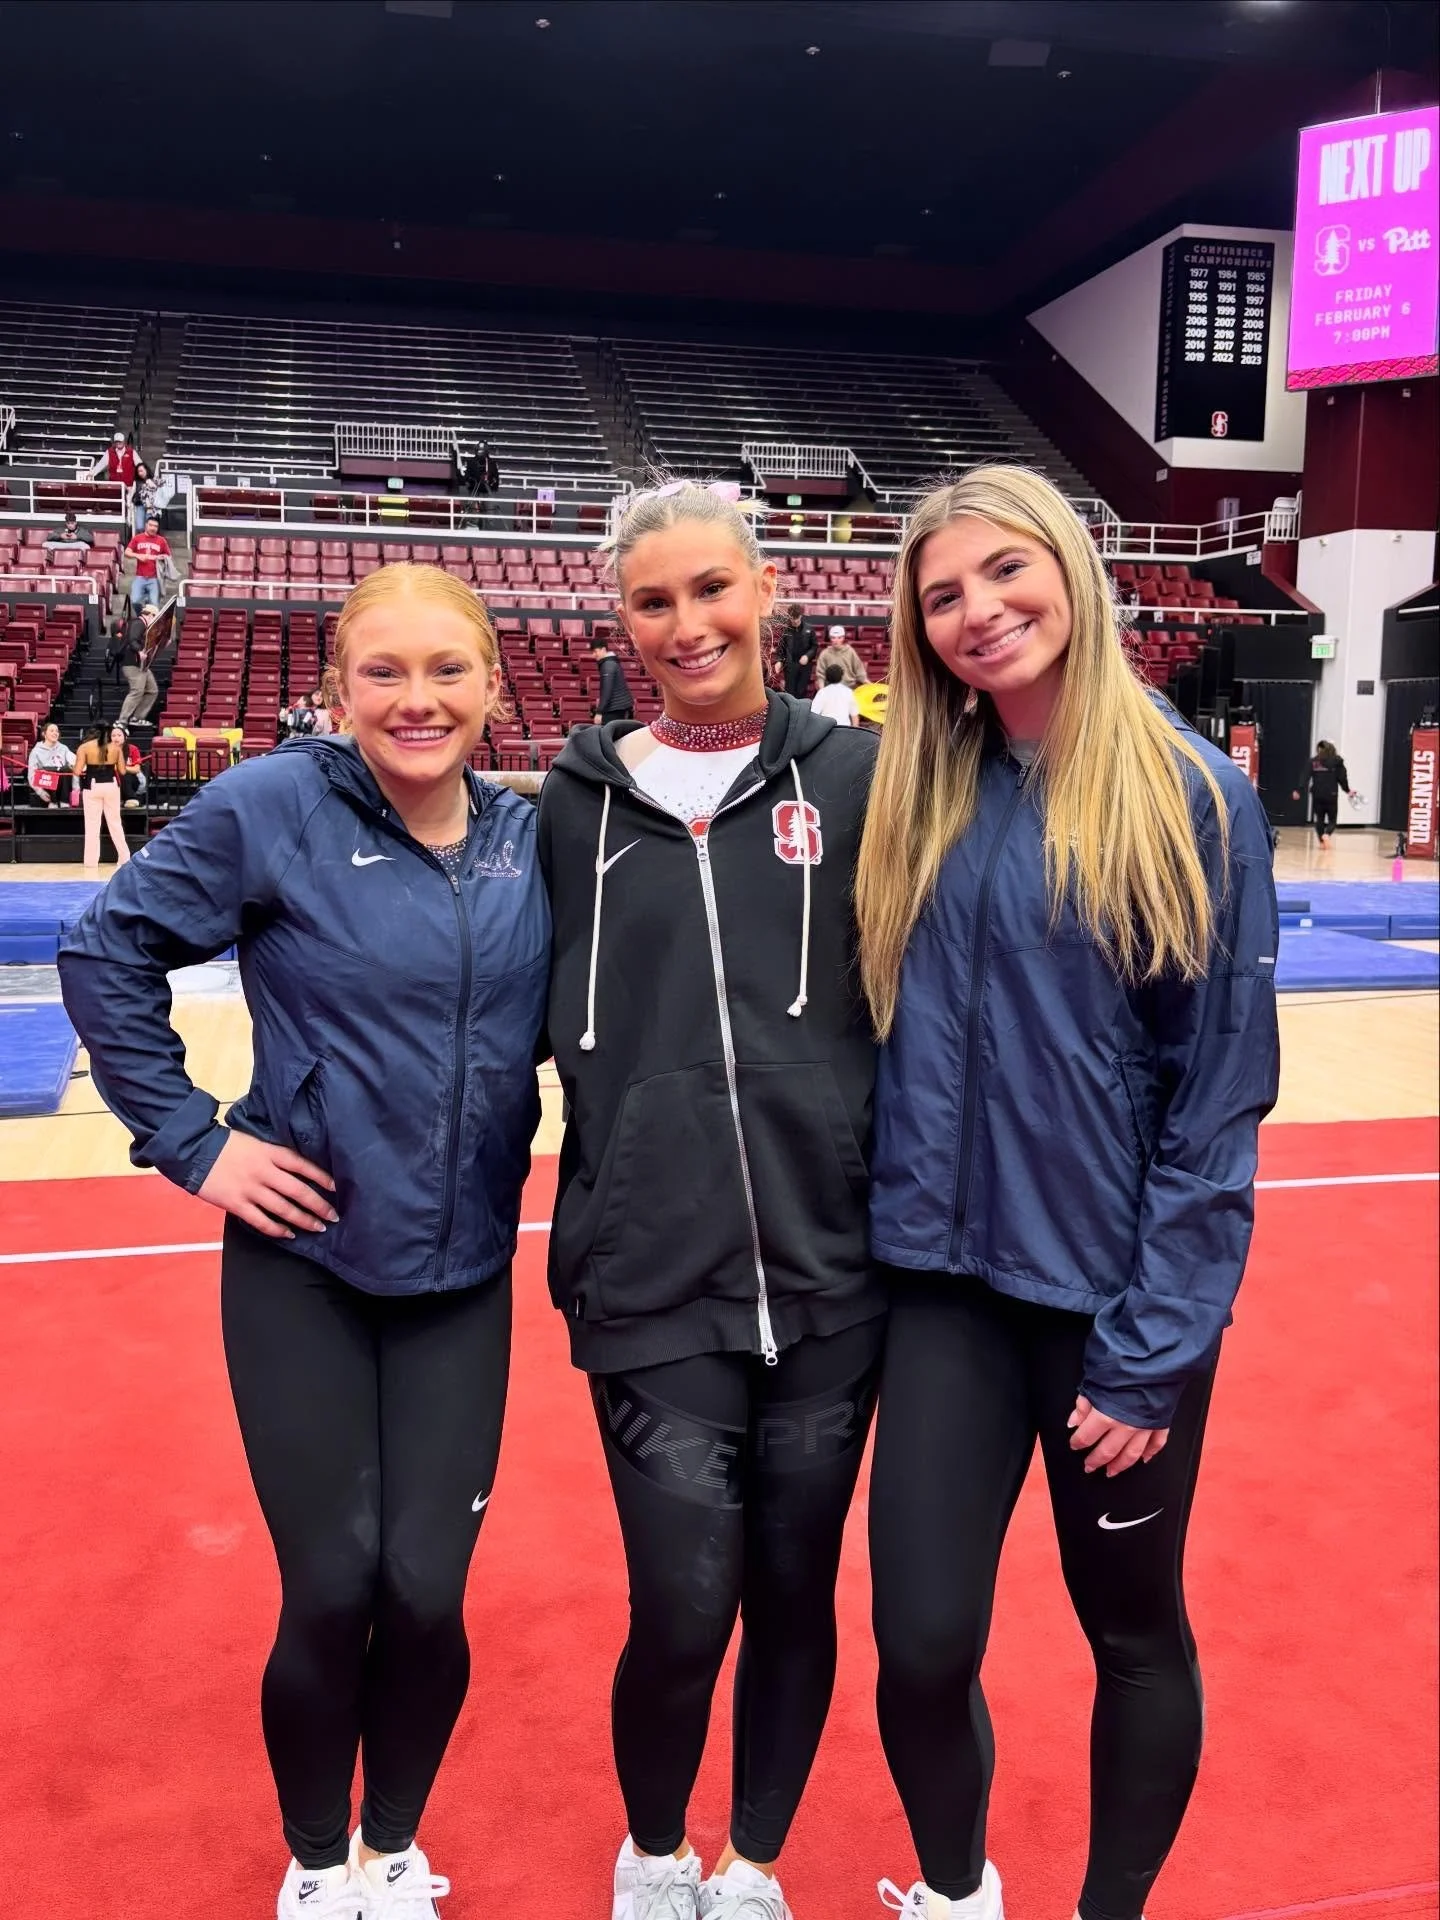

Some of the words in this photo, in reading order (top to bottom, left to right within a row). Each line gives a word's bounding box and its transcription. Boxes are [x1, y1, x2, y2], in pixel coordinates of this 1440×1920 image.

[1320, 135, 1387, 205] NEXT
[1393, 128, 1431, 193] UP
[1358, 238, 1375, 252] VS
[1382, 227, 1431, 254] Pitt
[1193, 245, 1264, 257] CONFERENCE
[1184, 254, 1272, 268] CHAMPIONSHIPS
[1189, 268, 1208, 277] 1977
[1218, 270, 1237, 279] 1984
[1247, 272, 1266, 281] 1985
[1189, 280, 1208, 290] 1987
[1217, 282, 1236, 291] 1991
[1246, 284, 1265, 293] 1994
[1189, 292, 1208, 302] 1995
[1217, 294, 1236, 303] 1996
[1246, 296, 1264, 305] 1997
[1335, 284, 1392, 304] FRIDAY
[1188, 304, 1207, 314] 1998
[1216, 306, 1236, 316] 1999
[1244, 307, 1264, 317] 2001
[1315, 304, 1391, 326] FEBRUARY
[1401, 302, 1411, 315] 6
[1186, 316, 1207, 326] 2006
[1214, 317, 1236, 327] 2007
[1242, 319, 1264, 329] 2008
[1214, 329, 1235, 339] 2010
[1242, 331, 1262, 341] 2012
[1333, 325, 1391, 344] 7:00PM
[1185, 340, 1205, 350] 2014
[1213, 341, 1234, 350] 2017
[1242, 343, 1262, 353] 2018
[1185, 352, 1205, 362] 2019
[1212, 352, 1234, 362] 2022
[1241, 355, 1262, 365] 2023
[1211, 411, 1228, 437] S
[1409, 750, 1435, 845] STANFORD
[772, 800, 823, 865] S
[600, 1382, 739, 1489] NIKE
[389, 1860, 409, 1873] NIKE
[301, 1880, 320, 1890] NIKE
